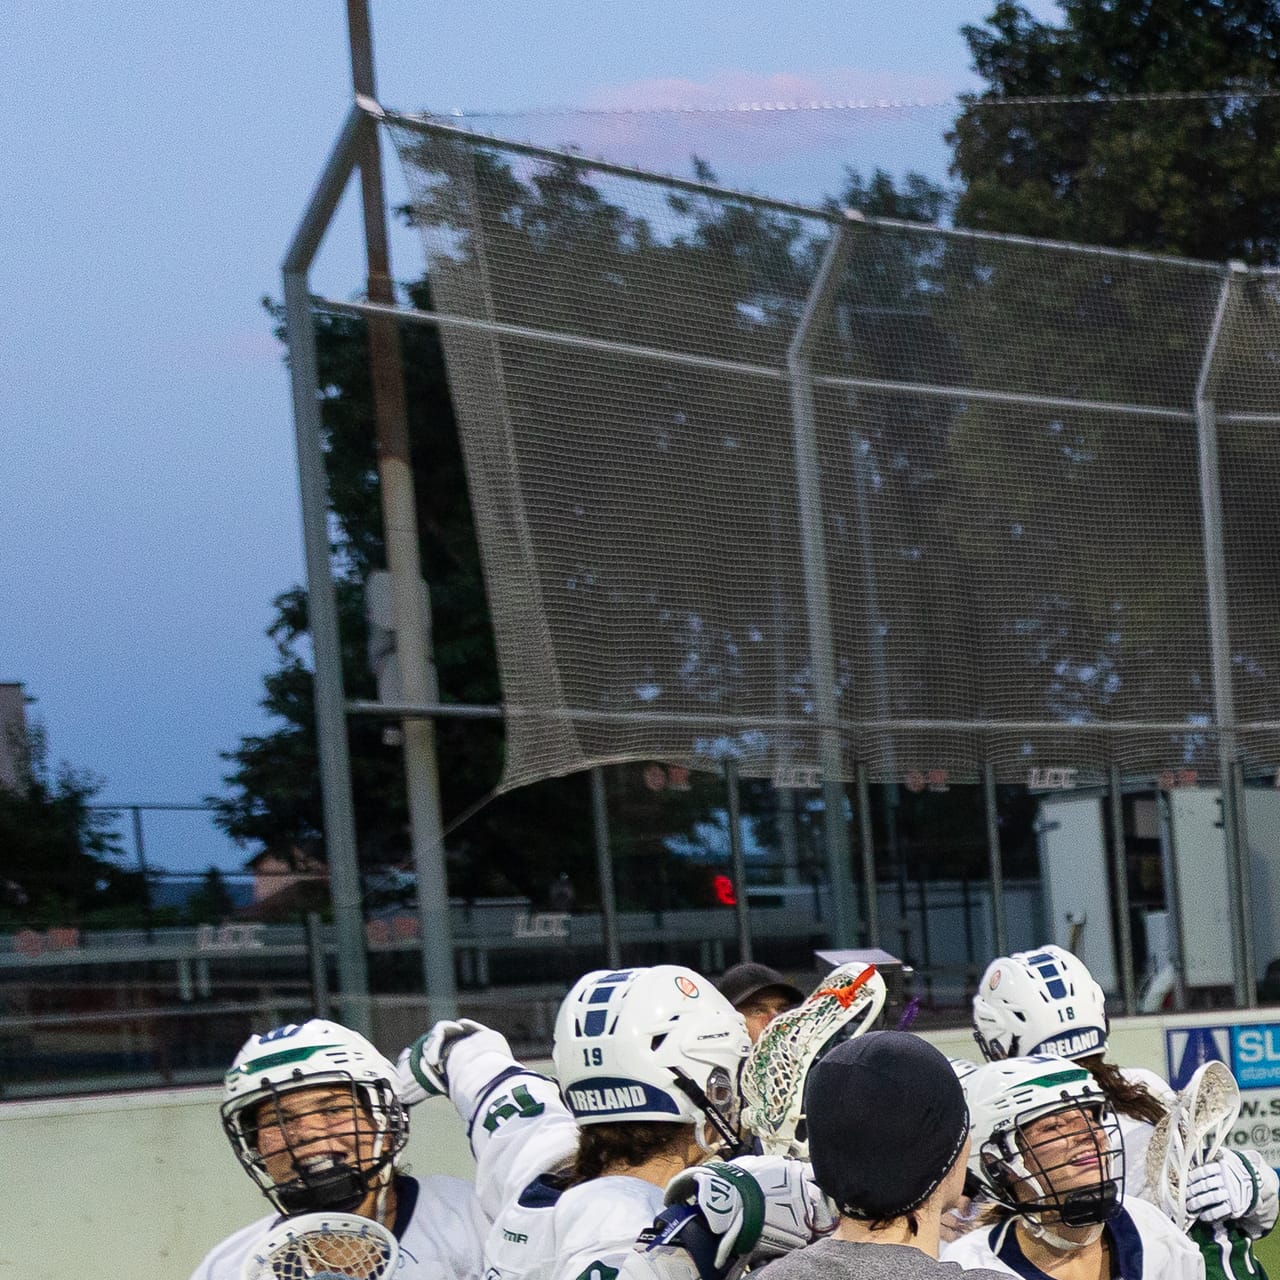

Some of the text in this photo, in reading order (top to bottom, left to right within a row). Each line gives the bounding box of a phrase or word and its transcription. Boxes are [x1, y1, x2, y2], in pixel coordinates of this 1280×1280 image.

[1058, 1006, 1075, 1023] 18
[1040, 1030, 1099, 1056] IRELAND
[583, 1047, 603, 1067] 19
[569, 1086, 648, 1111] IRELAND
